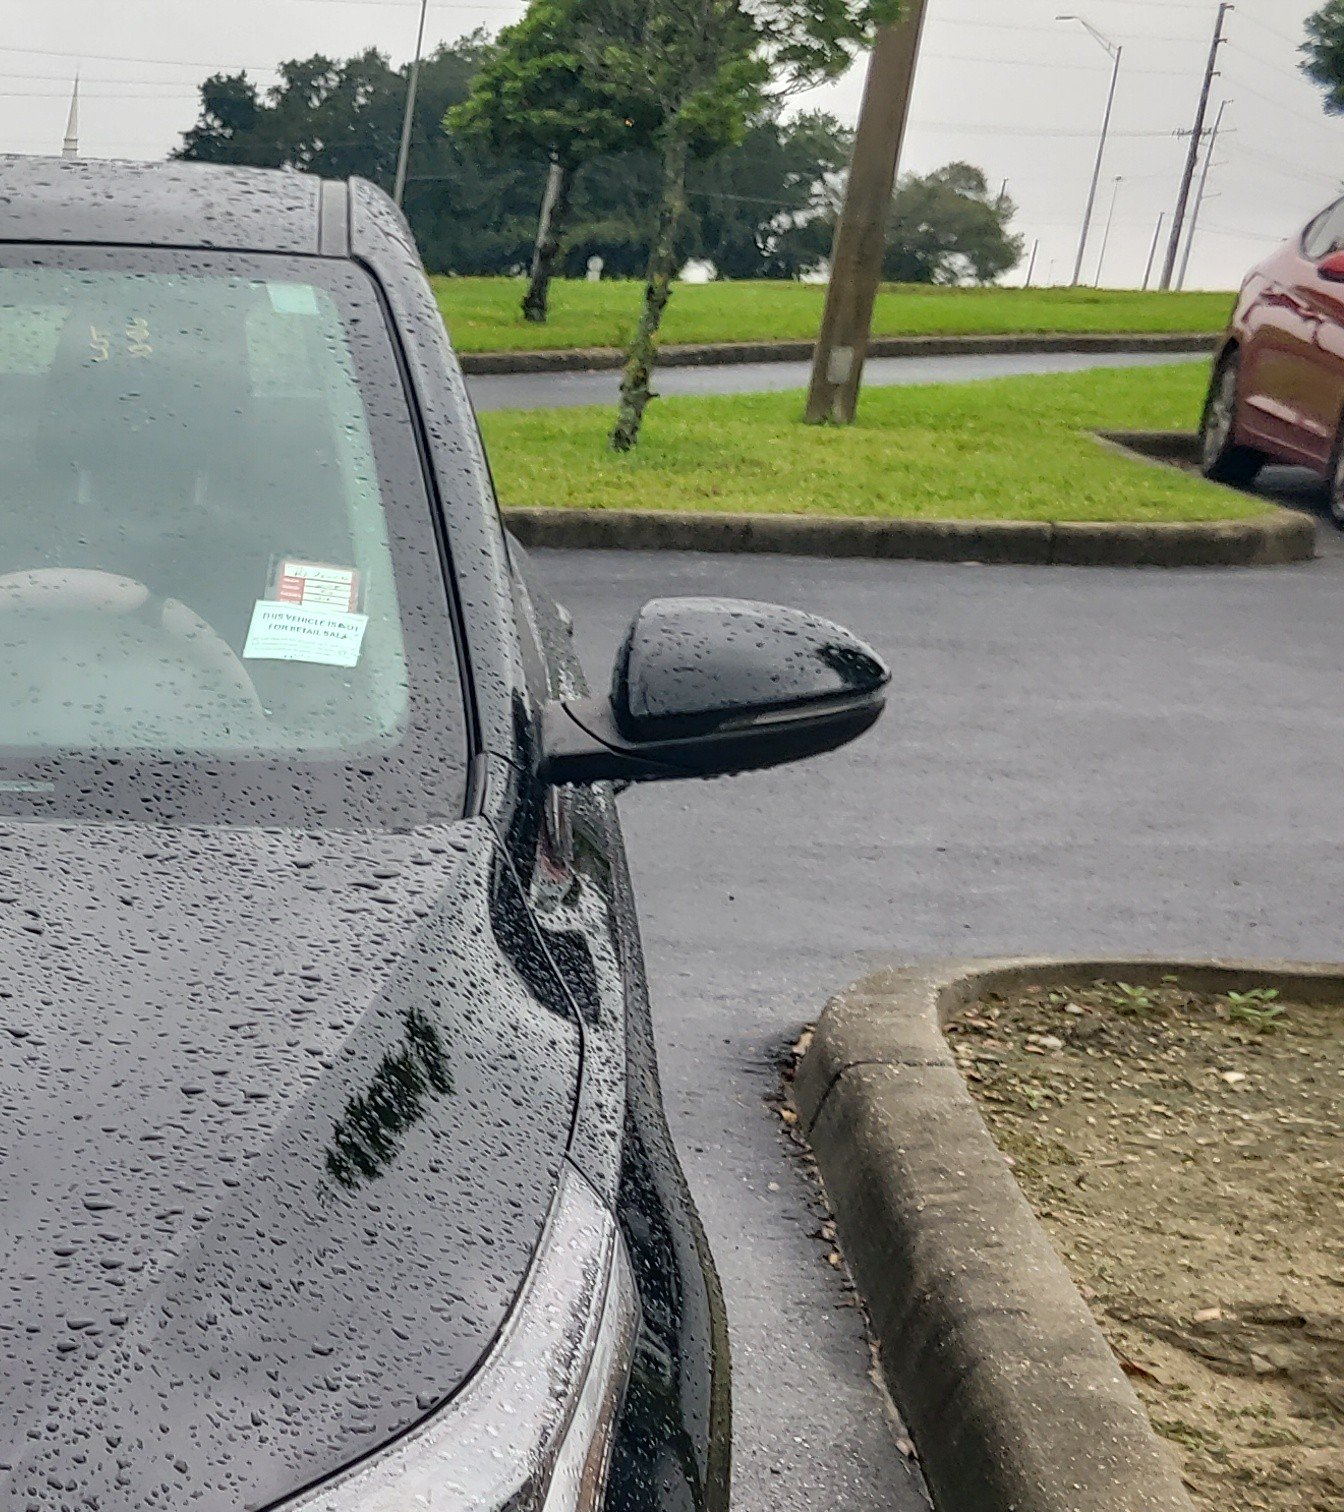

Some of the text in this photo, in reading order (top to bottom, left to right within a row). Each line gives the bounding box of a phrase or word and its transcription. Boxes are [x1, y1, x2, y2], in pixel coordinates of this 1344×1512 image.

[262, 612, 283, 620] THIS
[286, 614, 325, 626] VEHICLE
[290, 626, 320, 636] RETAIL
